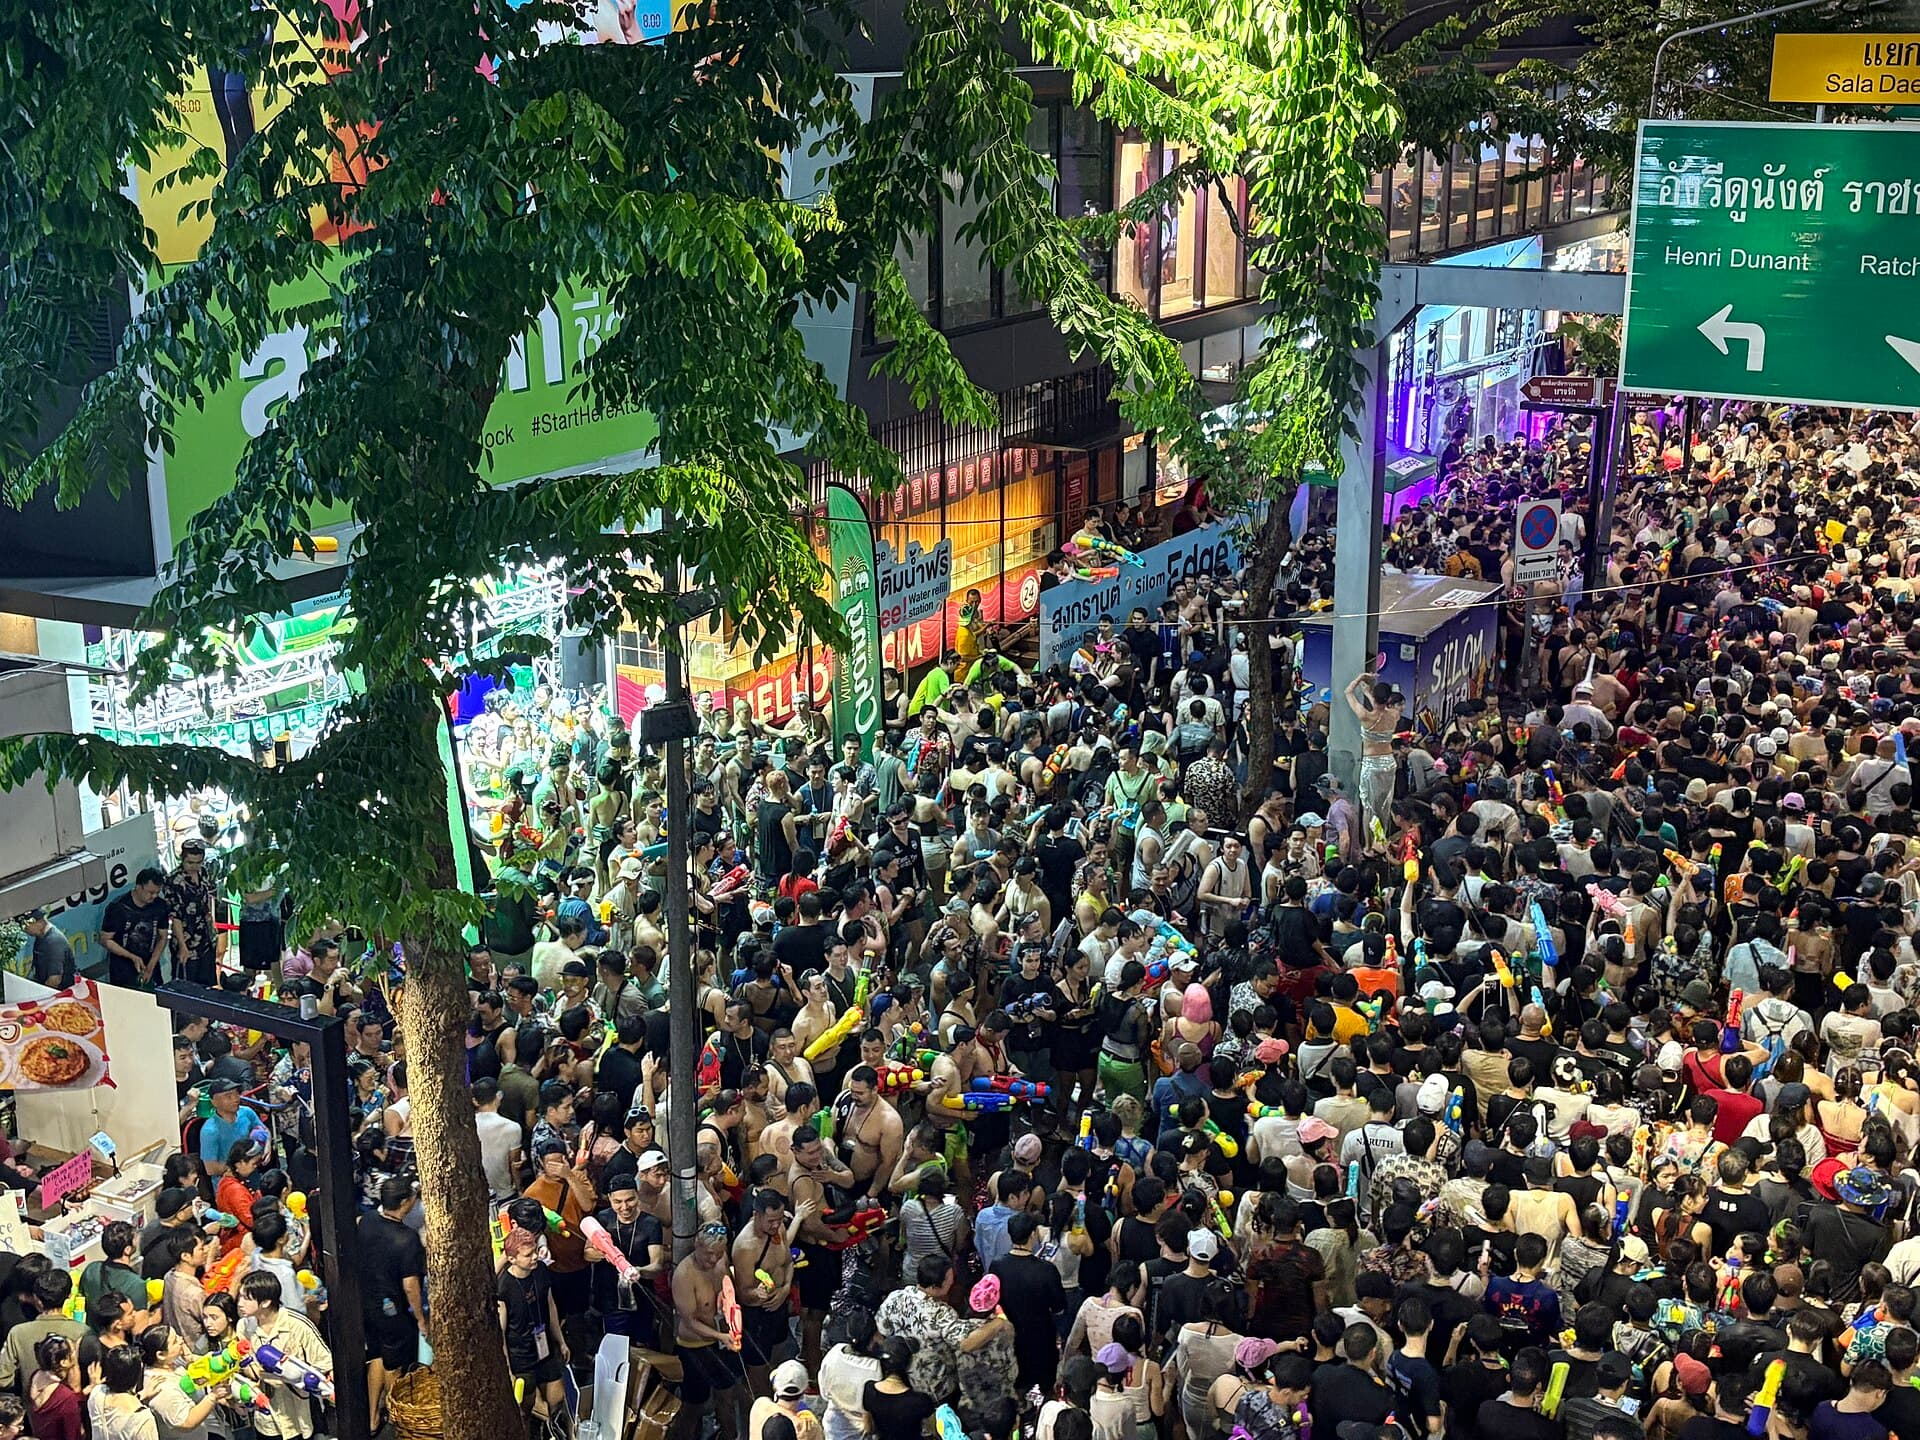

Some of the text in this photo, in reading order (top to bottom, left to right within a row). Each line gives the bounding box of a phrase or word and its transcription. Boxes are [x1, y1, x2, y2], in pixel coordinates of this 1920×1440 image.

[1826, 73, 1873, 93] Sala
[1658, 160, 1830, 223] อังรีดูนังต์
[1664, 246, 1810, 271] Henri Dunant
[880, 545, 949, 599] ติมน้ำฟรี
[1135, 571, 1166, 597] Silom
[908, 589, 931, 606] Water
[908, 601, 934, 619] station
[1051, 574, 1122, 635] สงกรานต์
